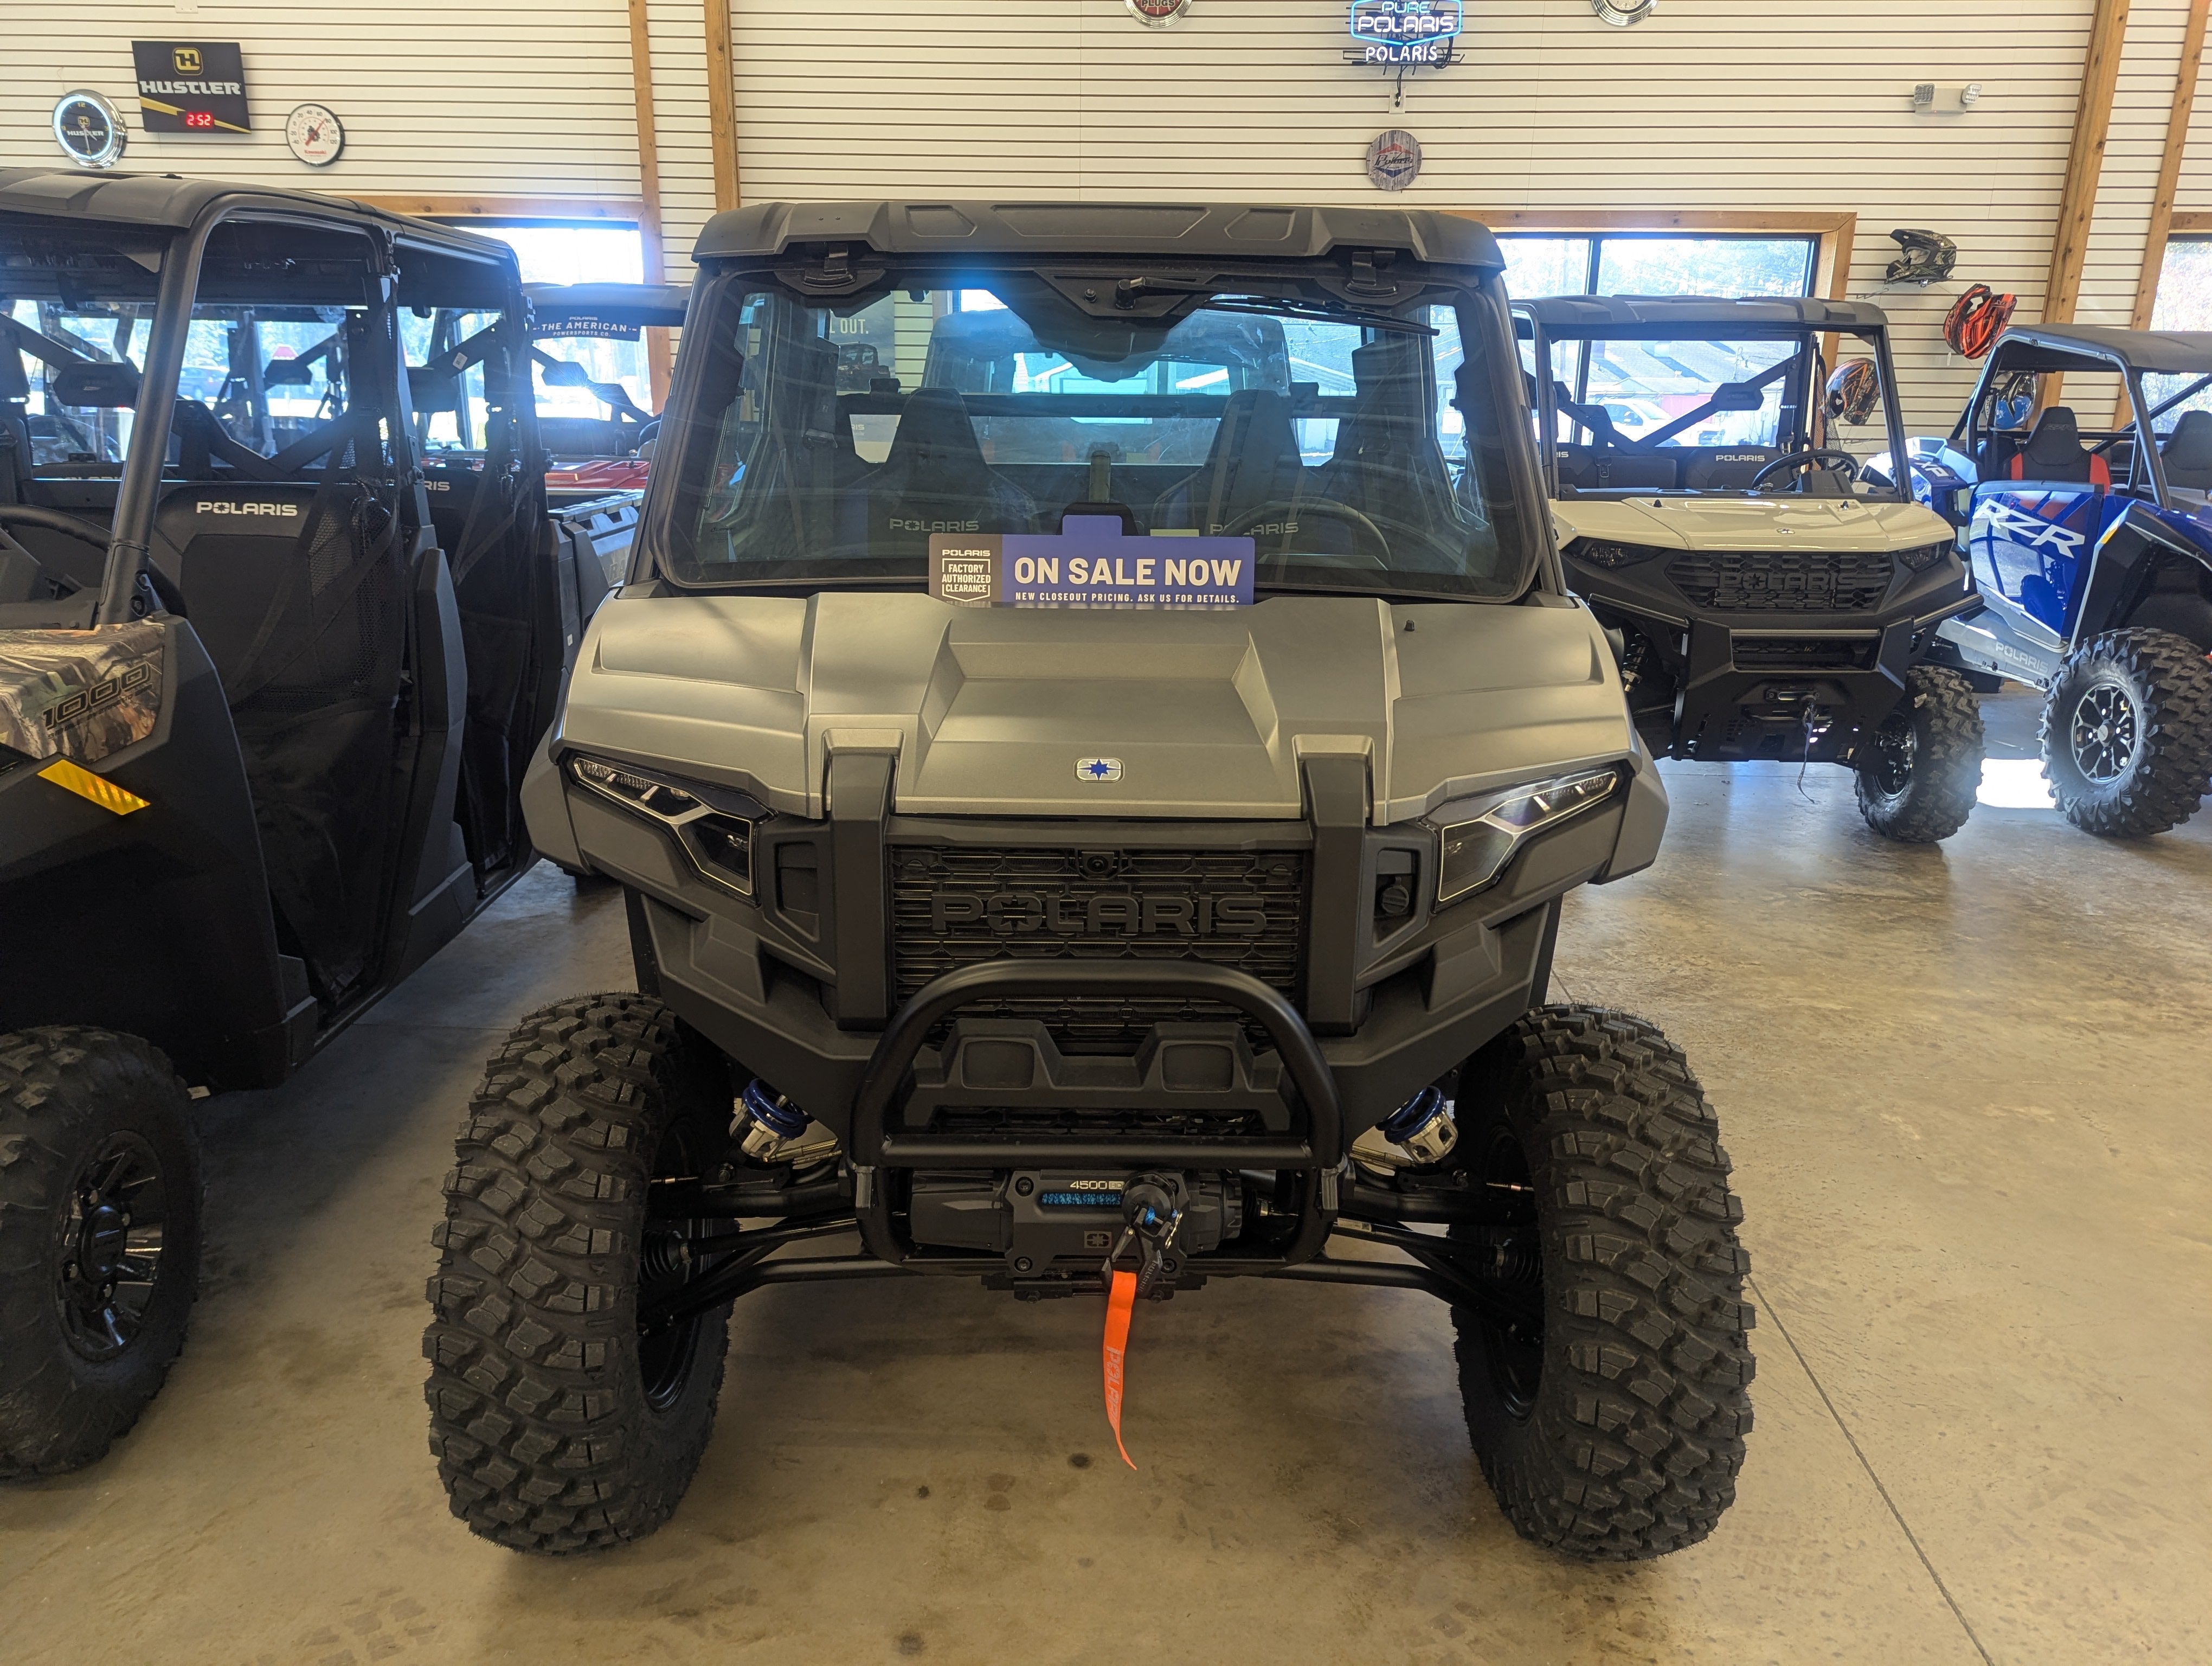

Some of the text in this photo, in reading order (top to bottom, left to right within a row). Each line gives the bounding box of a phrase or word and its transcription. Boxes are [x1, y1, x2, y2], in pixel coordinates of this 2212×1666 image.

[1382, 1, 1430, 13] PURE
[1358, 16, 1454, 33] POLARIS
[1366, 46, 1437, 62] POLARIS
[139, 81, 241, 94] HUSTLER
[542, 322, 627, 332] THE AMERICAN
[840, 318, 869, 334] OUT.
[1914, 461, 1950, 477] XP
[196, 502, 298, 516] POLARIS
[889, 518, 980, 532] POLARIS
[1210, 522, 1299, 536] PARIS
[1972, 498, 2085, 559] RZR
[948, 563, 984, 573] FACTORY
[1015, 557, 1242, 586] ON SALE NOW
[942, 574, 992, 584] AUTHORIZED
[1720, 572, 1854, 591] POLARIS
[946, 584, 987, 593] CLEARANCE
[1015, 592, 1239, 603] NEW CLOSEOUT PRICING. ASK US FOR DETAILS.
[1996, 641, 2049, 672] POLARIS
[43, 661, 151, 731] 1000
[931, 894, 1268, 934] POLARIS
[1070, 1180, 1108, 1190] 4500
